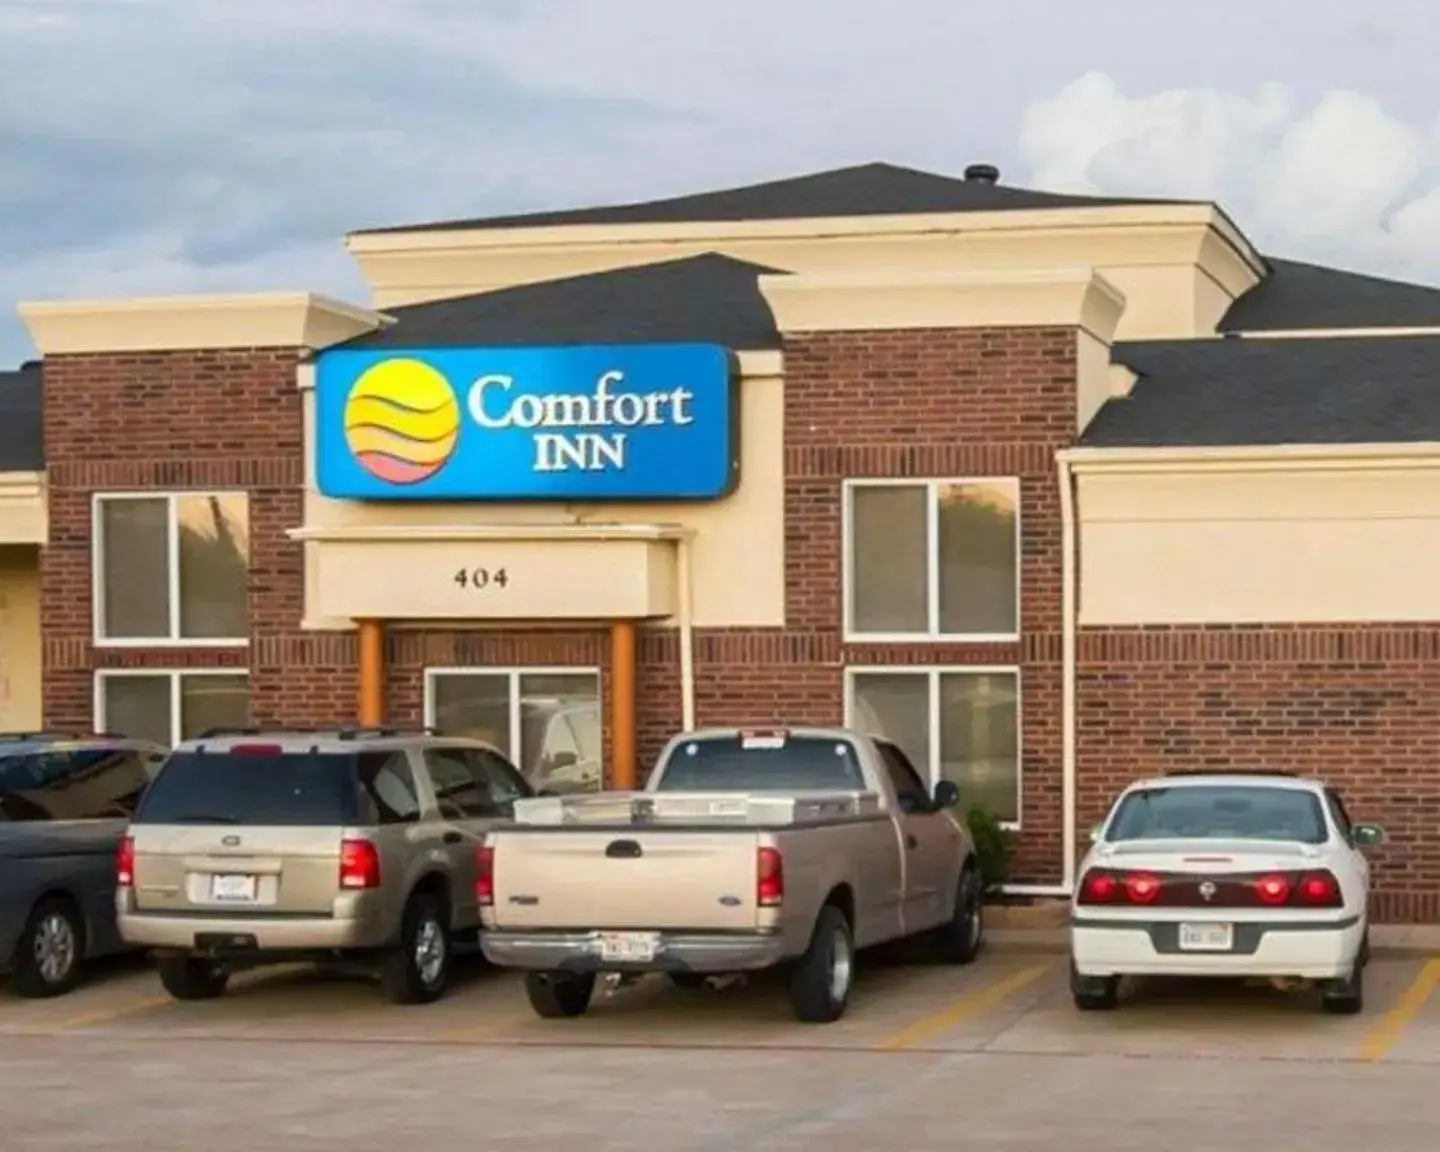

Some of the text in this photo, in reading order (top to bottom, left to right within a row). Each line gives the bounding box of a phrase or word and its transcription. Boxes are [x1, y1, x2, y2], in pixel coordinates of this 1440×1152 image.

[468, 370, 694, 428] Comfort
[533, 433, 627, 470] INN
[454, 567, 509, 589] 404
